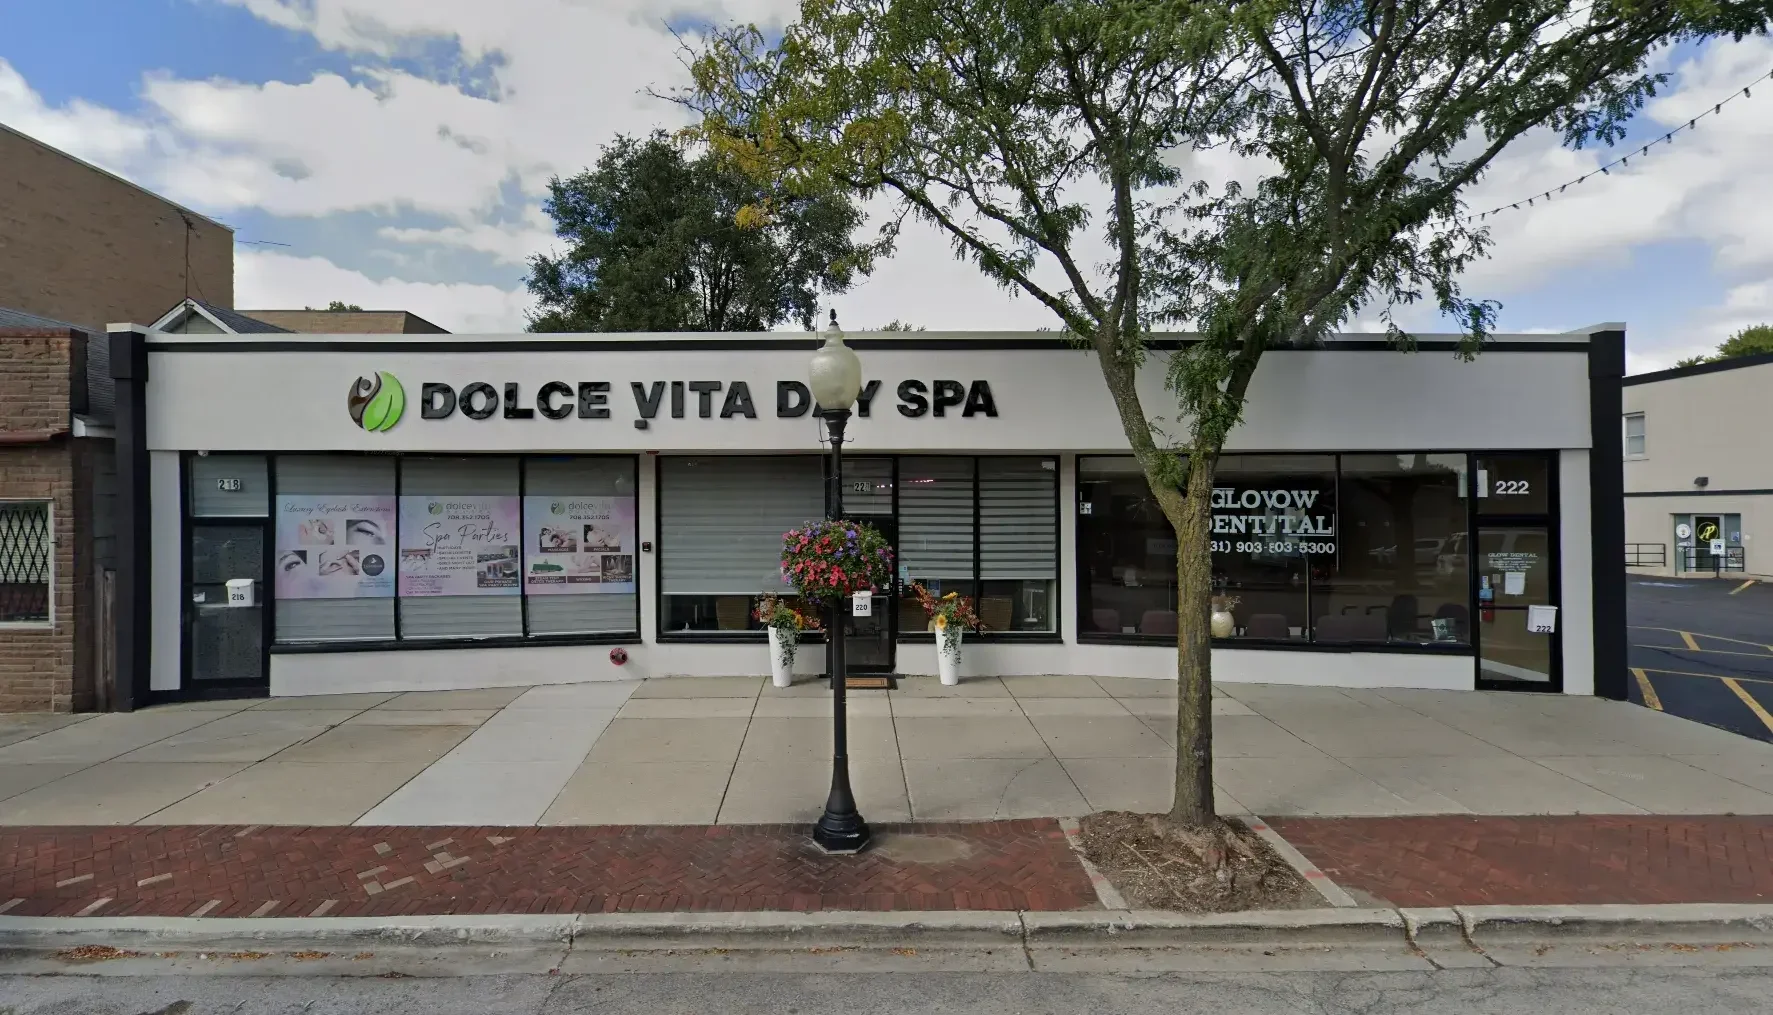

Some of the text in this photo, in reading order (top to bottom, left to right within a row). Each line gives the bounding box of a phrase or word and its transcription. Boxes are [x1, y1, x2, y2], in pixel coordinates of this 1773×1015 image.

[421, 379, 1000, 420] DOLCE VITA DY SPA
[218, 479, 240, 490] 218
[1495, 480, 1530, 495] 222
[423, 520, 508, 553] Spa Parties
